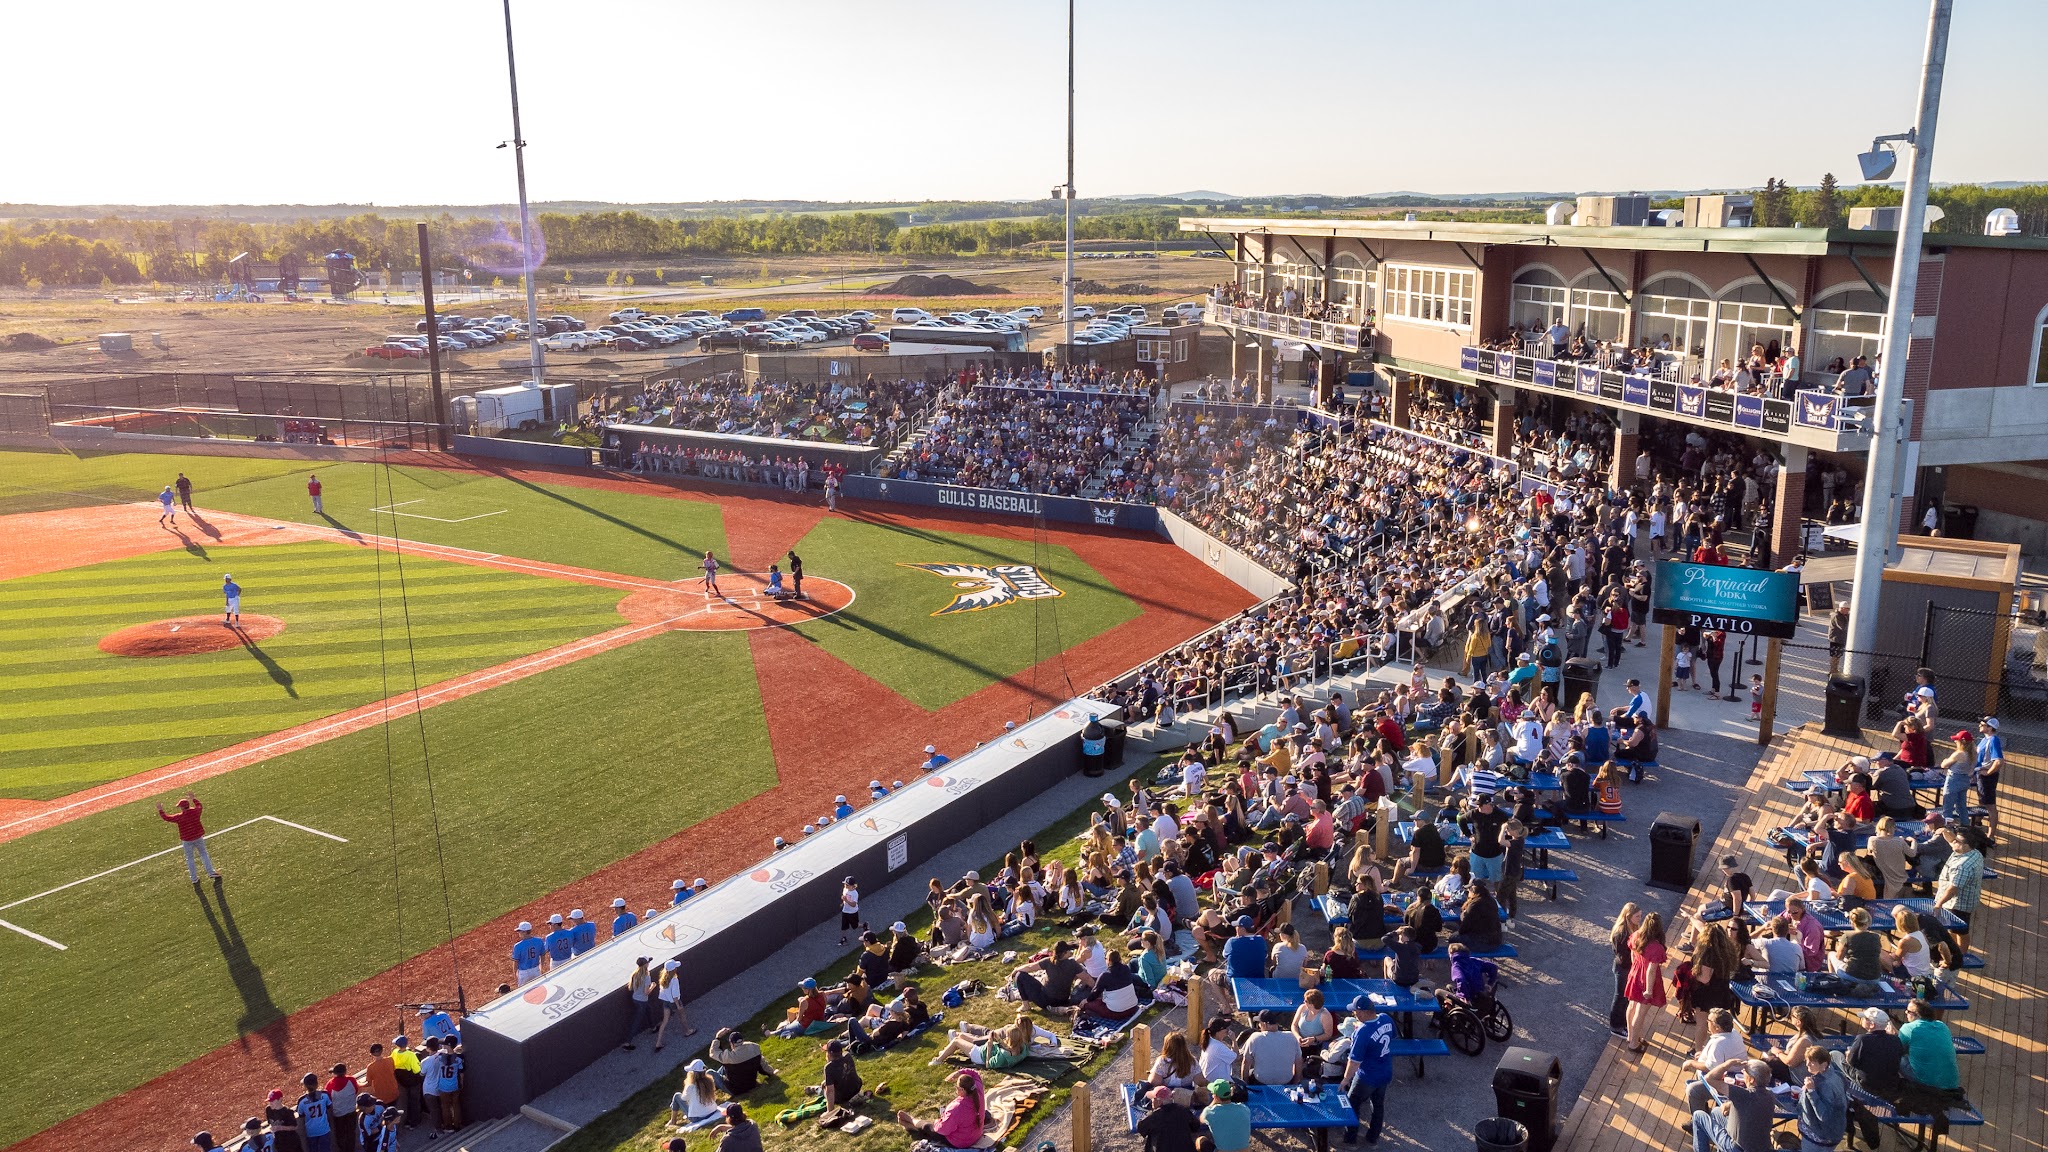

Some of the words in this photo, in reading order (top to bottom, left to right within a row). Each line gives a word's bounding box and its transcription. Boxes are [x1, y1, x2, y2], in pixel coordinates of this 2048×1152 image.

[1682, 404, 1698, 414] GULLS
[1807, 414, 1828, 425] GULLS
[938, 489, 976, 508] GULLS
[979, 493, 1042, 515] BASEBALL
[1095, 516, 1115, 525] GULLS
[1683, 567, 1769, 595] Provincial
[1690, 614, 1753, 633] PATIO
[1531, 727, 1538, 739] 4
[557, 938, 569, 950] 23
[527, 947, 536, 959] 16
[1379, 1034, 1391, 1058] 2
[441, 1065, 454, 1079] 16
[309, 1103, 323, 1119] 21
